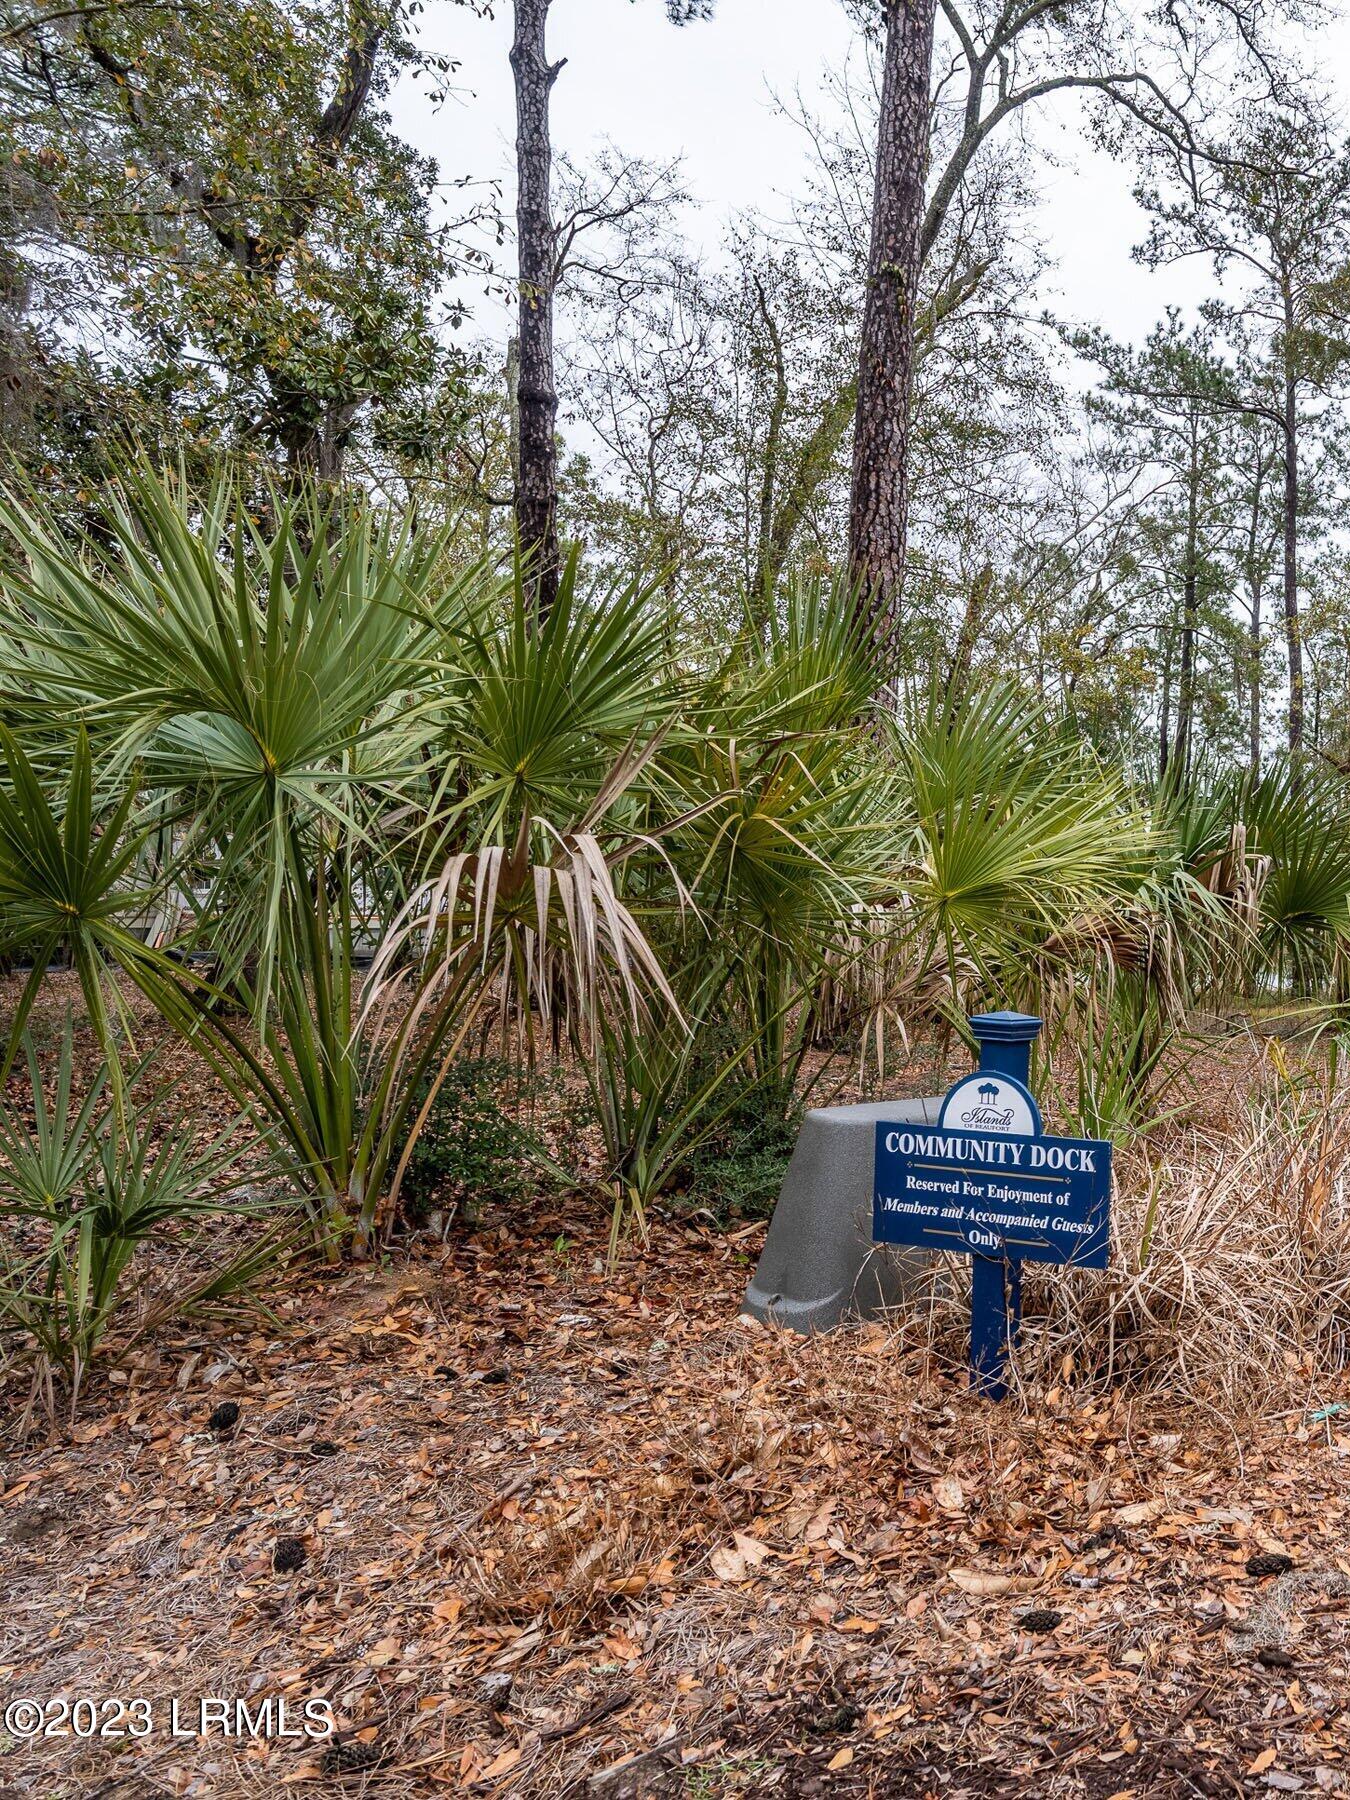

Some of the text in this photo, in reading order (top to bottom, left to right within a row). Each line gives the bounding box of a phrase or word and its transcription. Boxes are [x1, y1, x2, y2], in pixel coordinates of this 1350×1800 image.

[960, 1107, 1015, 1126] Islands
[885, 1131, 1096, 1173] COMMUNITY DOCK
[906, 1175, 1071, 1206] Reserved For Enjoyment of
[883, 1197, 1095, 1235] Members and Accompanied Guests
